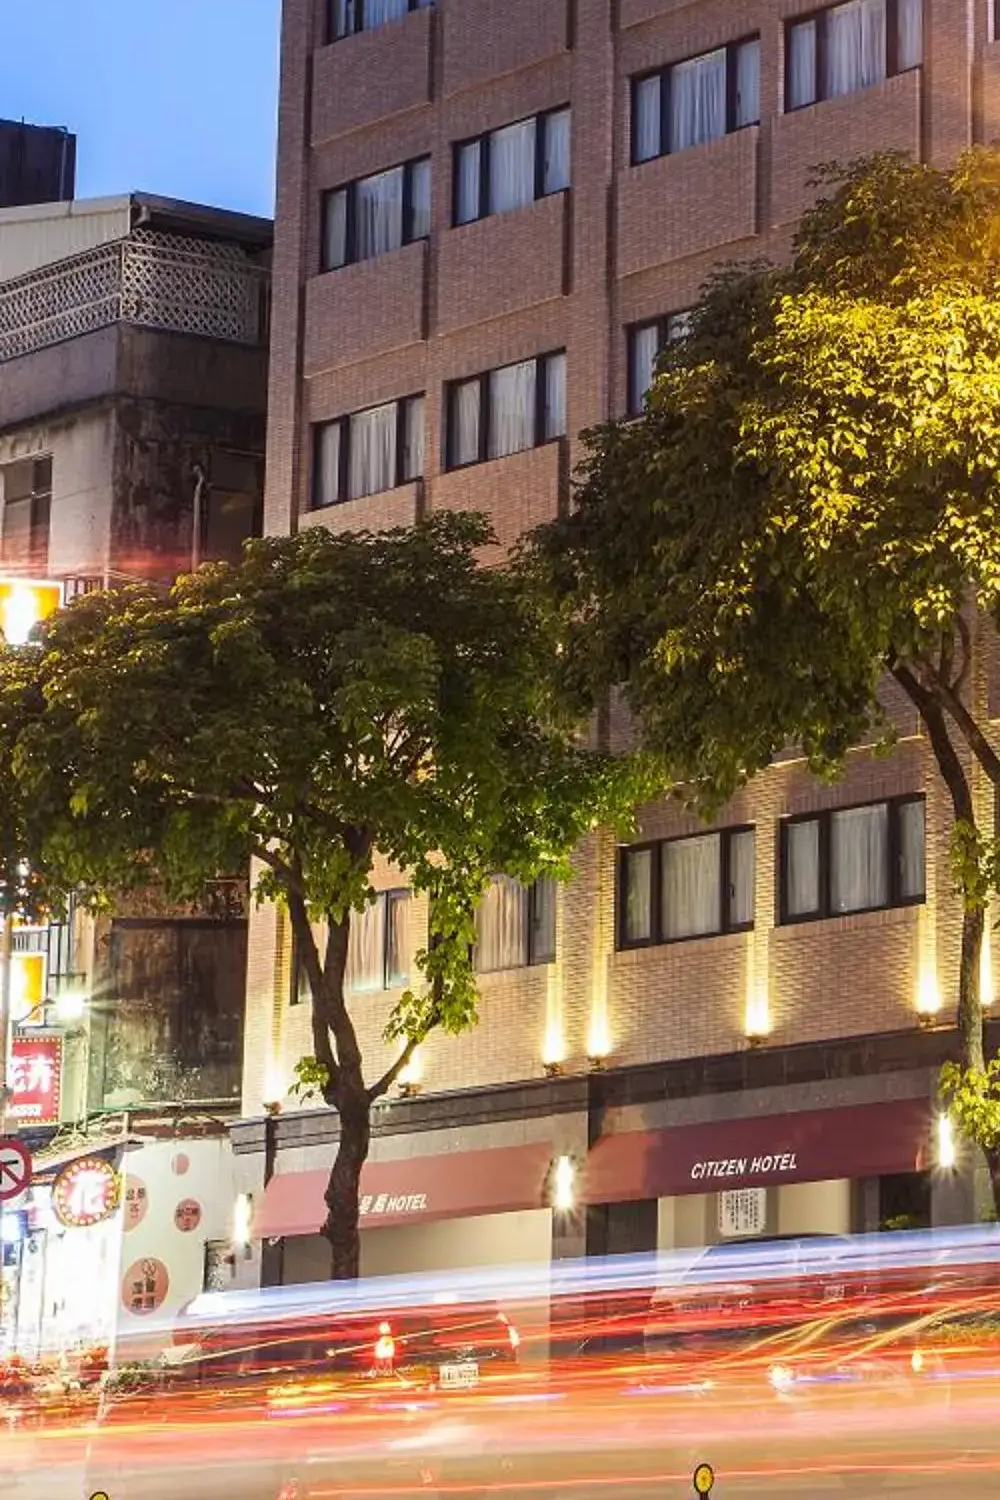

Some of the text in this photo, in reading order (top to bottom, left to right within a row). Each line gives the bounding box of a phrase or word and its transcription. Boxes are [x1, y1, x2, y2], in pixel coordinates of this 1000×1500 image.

[691, 1153, 797, 1179] CITIZEN HOTEL
[386, 1193, 427, 1213] HOTEL
